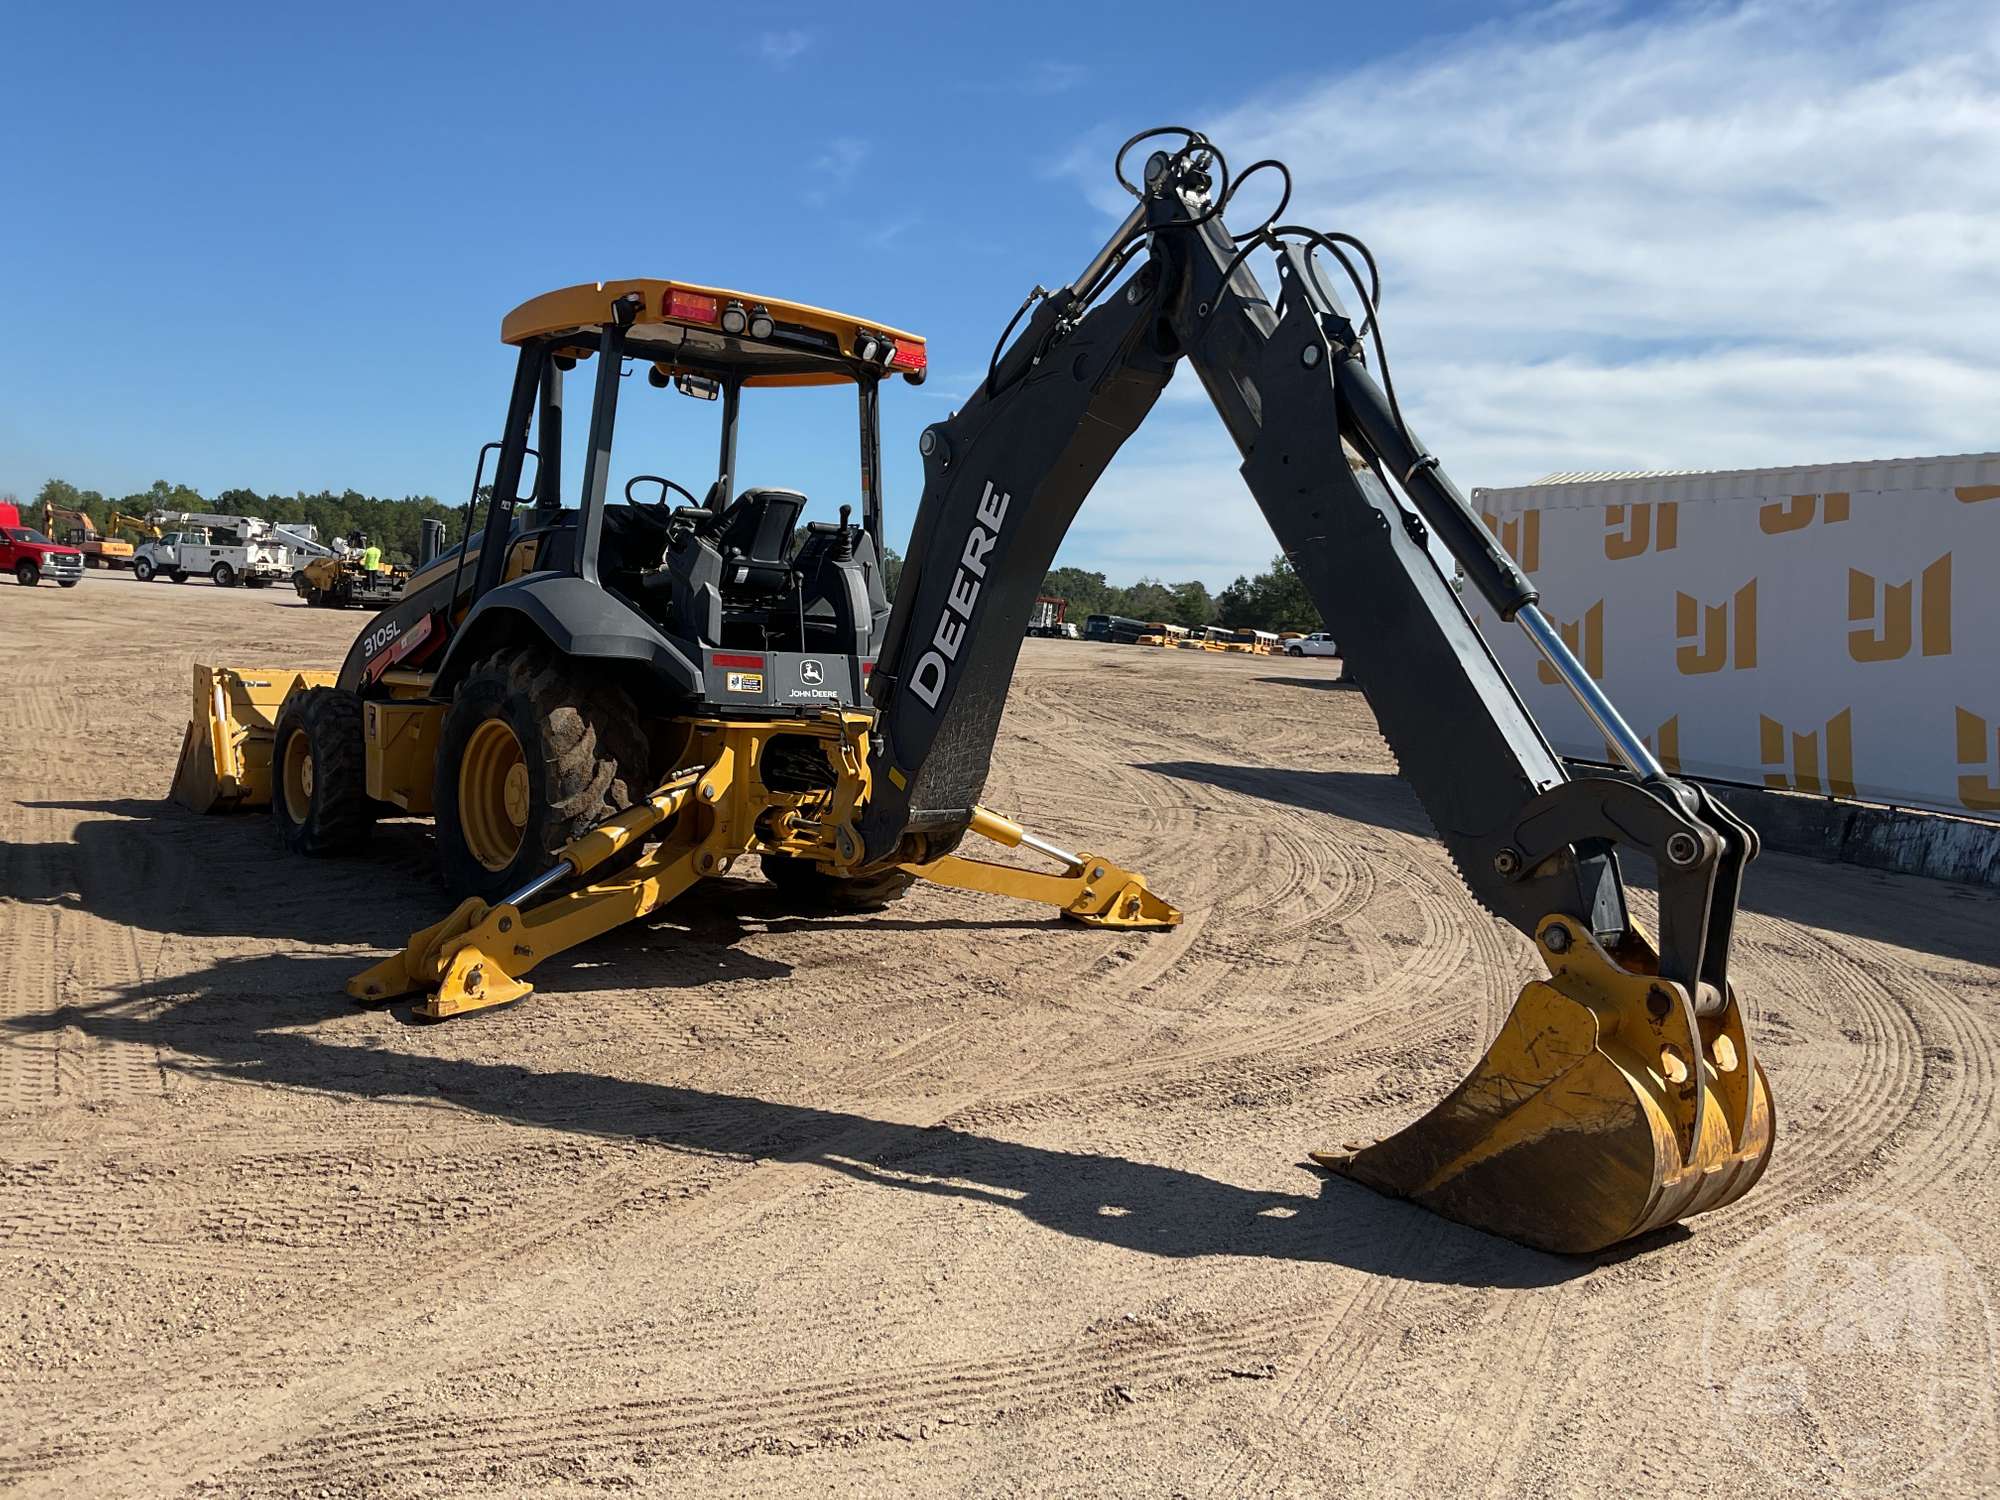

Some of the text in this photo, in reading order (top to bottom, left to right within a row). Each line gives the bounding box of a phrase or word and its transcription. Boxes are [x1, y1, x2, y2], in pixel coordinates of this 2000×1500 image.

[909, 480, 1011, 709] DEERE
[363, 620, 401, 657] 310SL
[789, 688, 838, 698] JOHN DEERE
